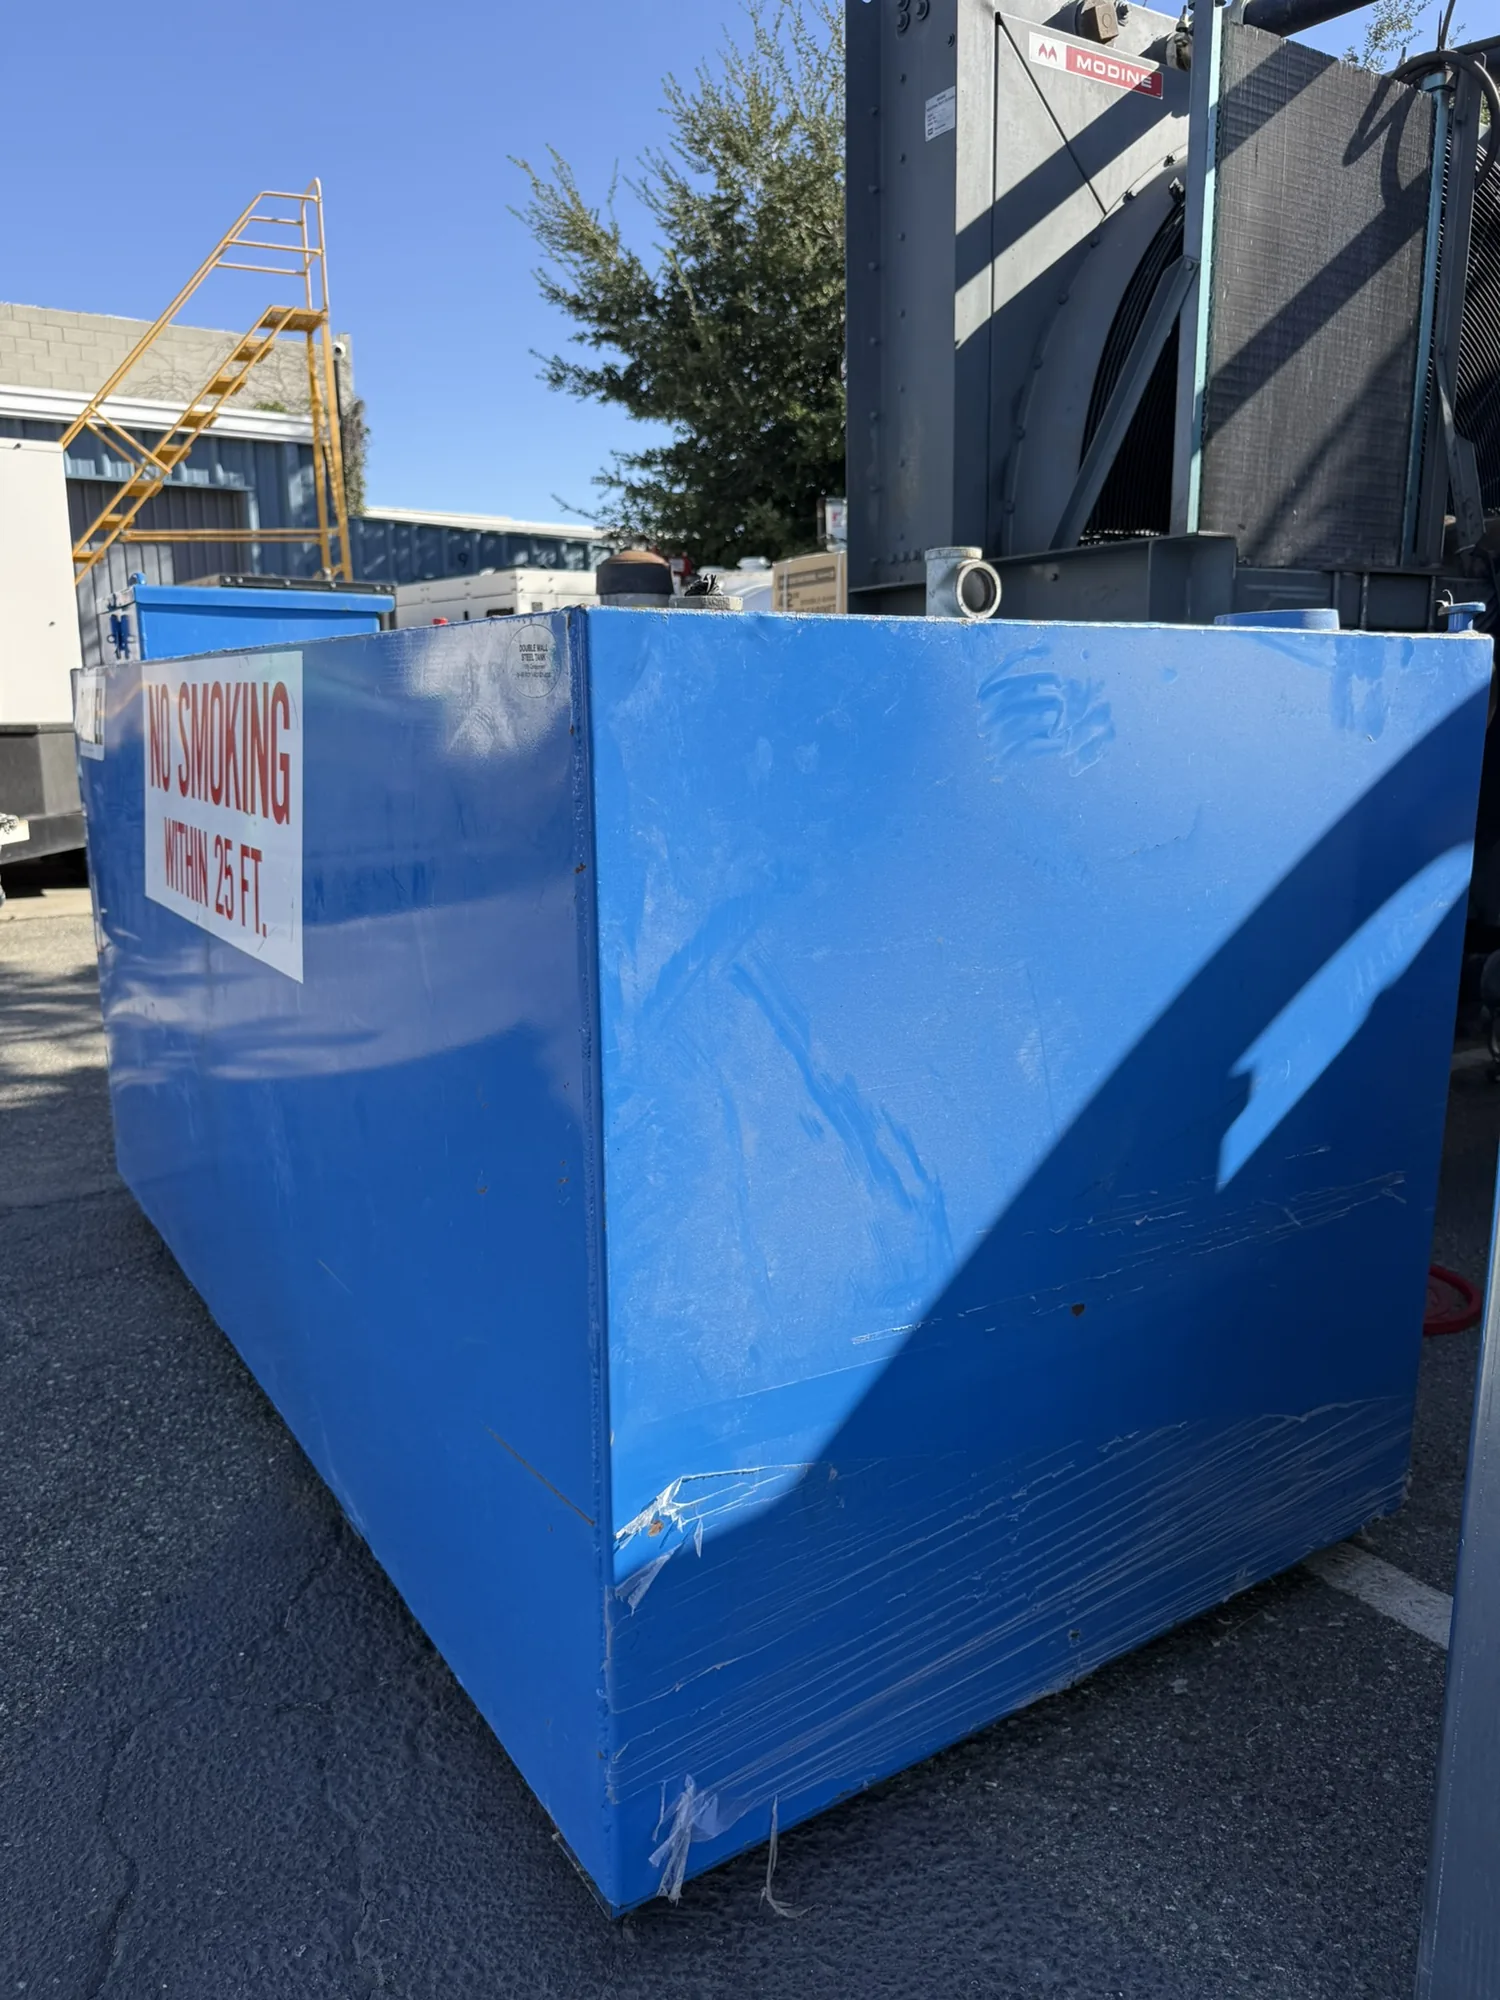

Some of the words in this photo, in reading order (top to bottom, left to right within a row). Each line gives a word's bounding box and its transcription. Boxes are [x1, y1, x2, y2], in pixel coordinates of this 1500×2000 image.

[1076, 55, 1152, 89] MODINE
[519, 644, 536, 652] DOUBLE
[537, 643, 548, 652] WALL
[521, 653, 534, 661] STEEL
[535, 653, 546, 661] TANK
[149, 683, 170, 793] NO
[178, 681, 291, 825] SMOKING
[164, 816, 209, 908] WITHIN
[214, 834, 235, 921] 25
[240, 843, 268, 938] FT.
